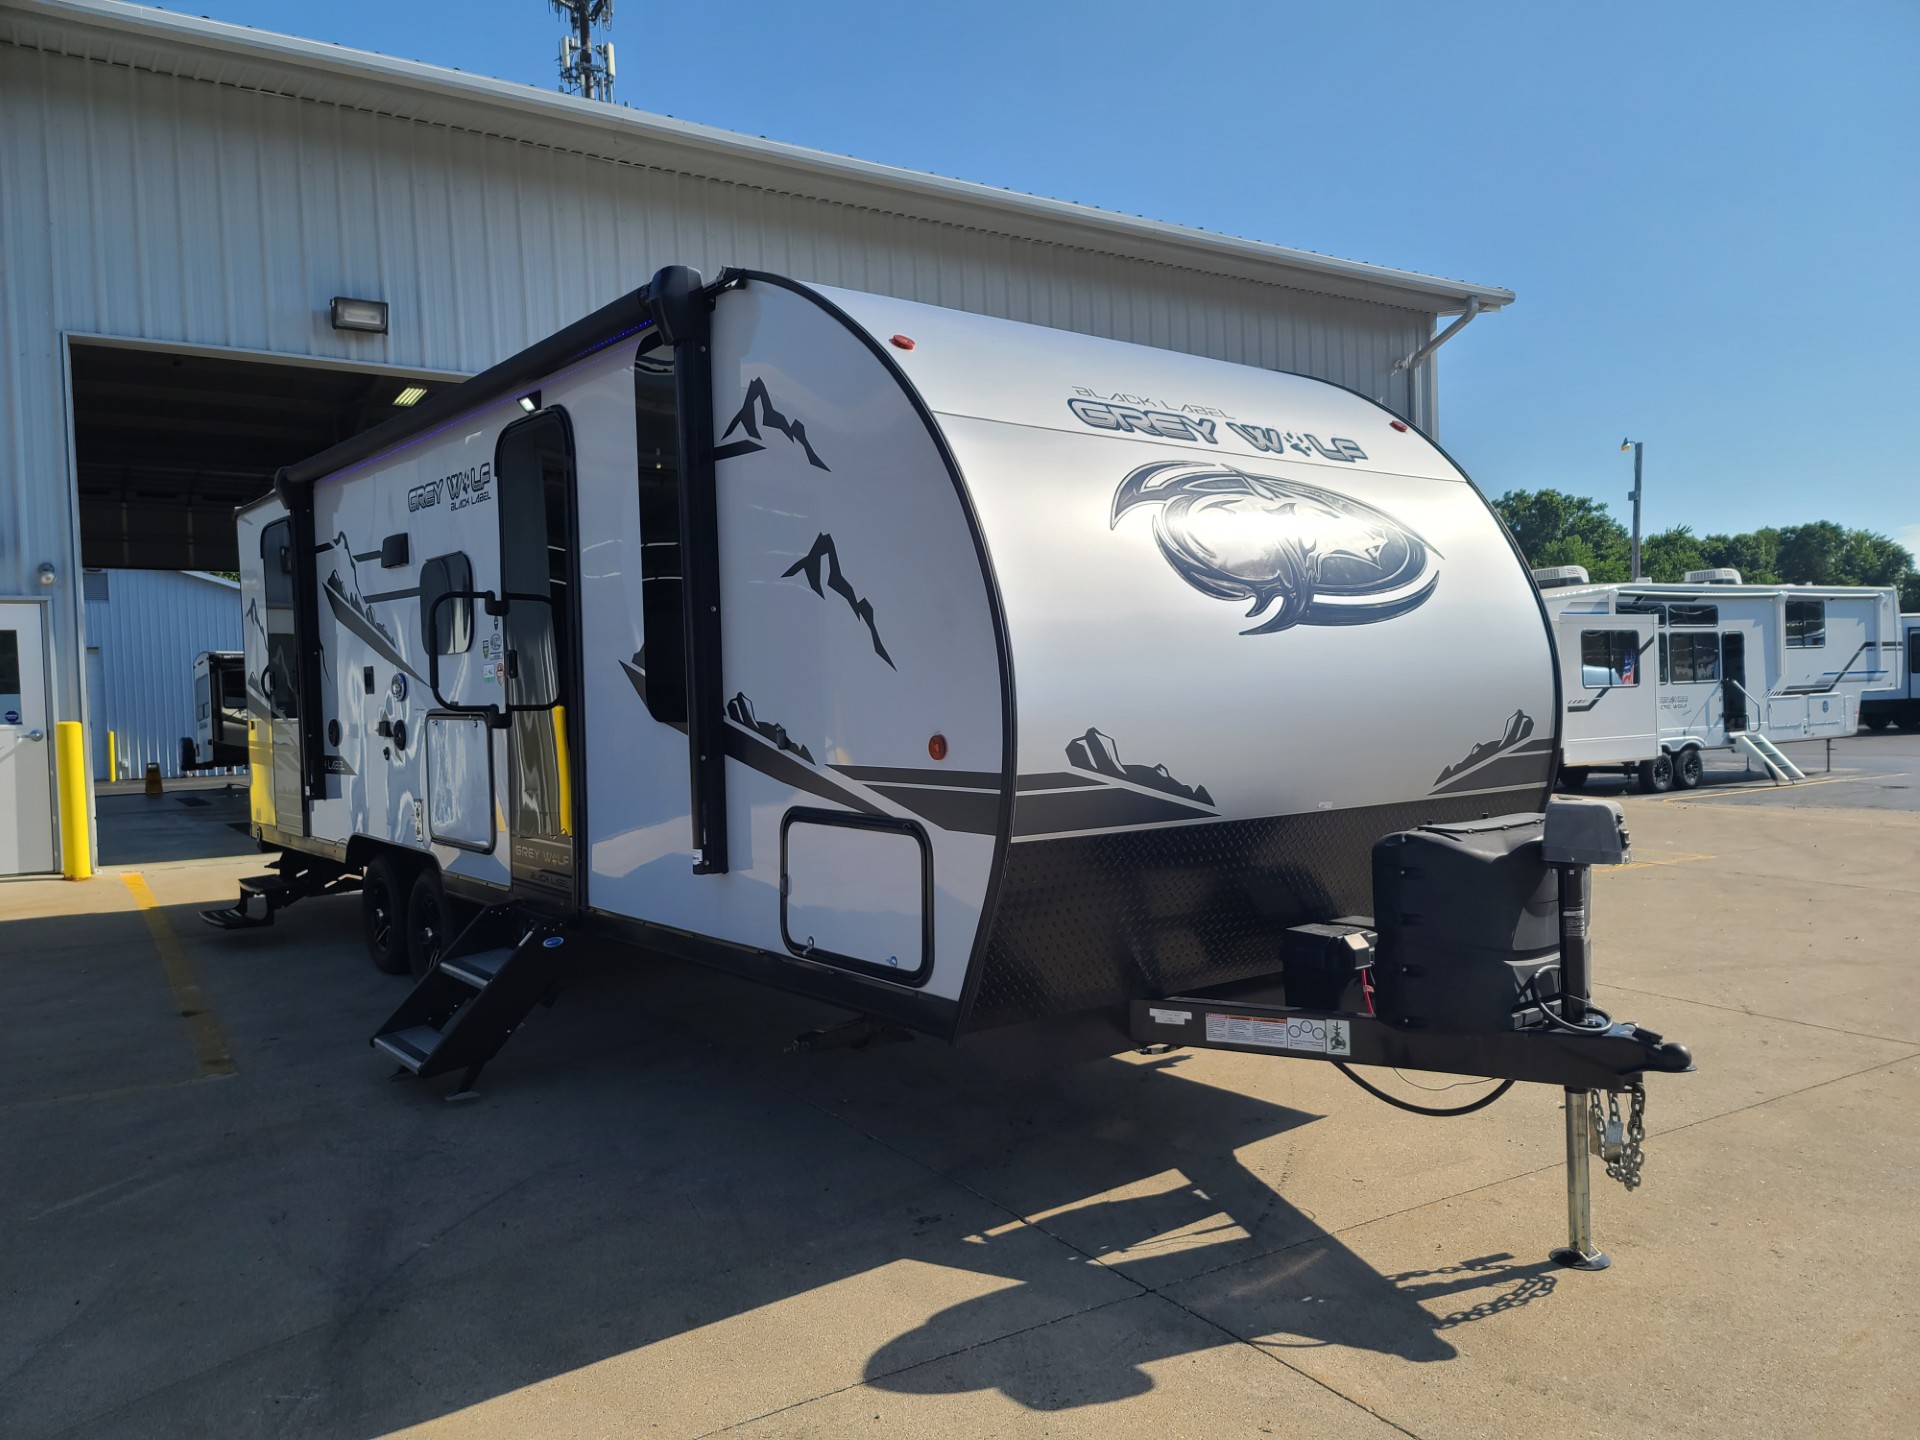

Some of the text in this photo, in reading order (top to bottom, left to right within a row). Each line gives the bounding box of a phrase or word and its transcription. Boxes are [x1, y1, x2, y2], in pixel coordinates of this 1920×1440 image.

[1072, 385, 1236, 420] BLACK LABEL
[1067, 397, 1219, 444] GREY
[408, 478, 444, 513] GREY
[450, 491, 492, 512] BLACK LABEL
[515, 844, 541, 860] GREY
